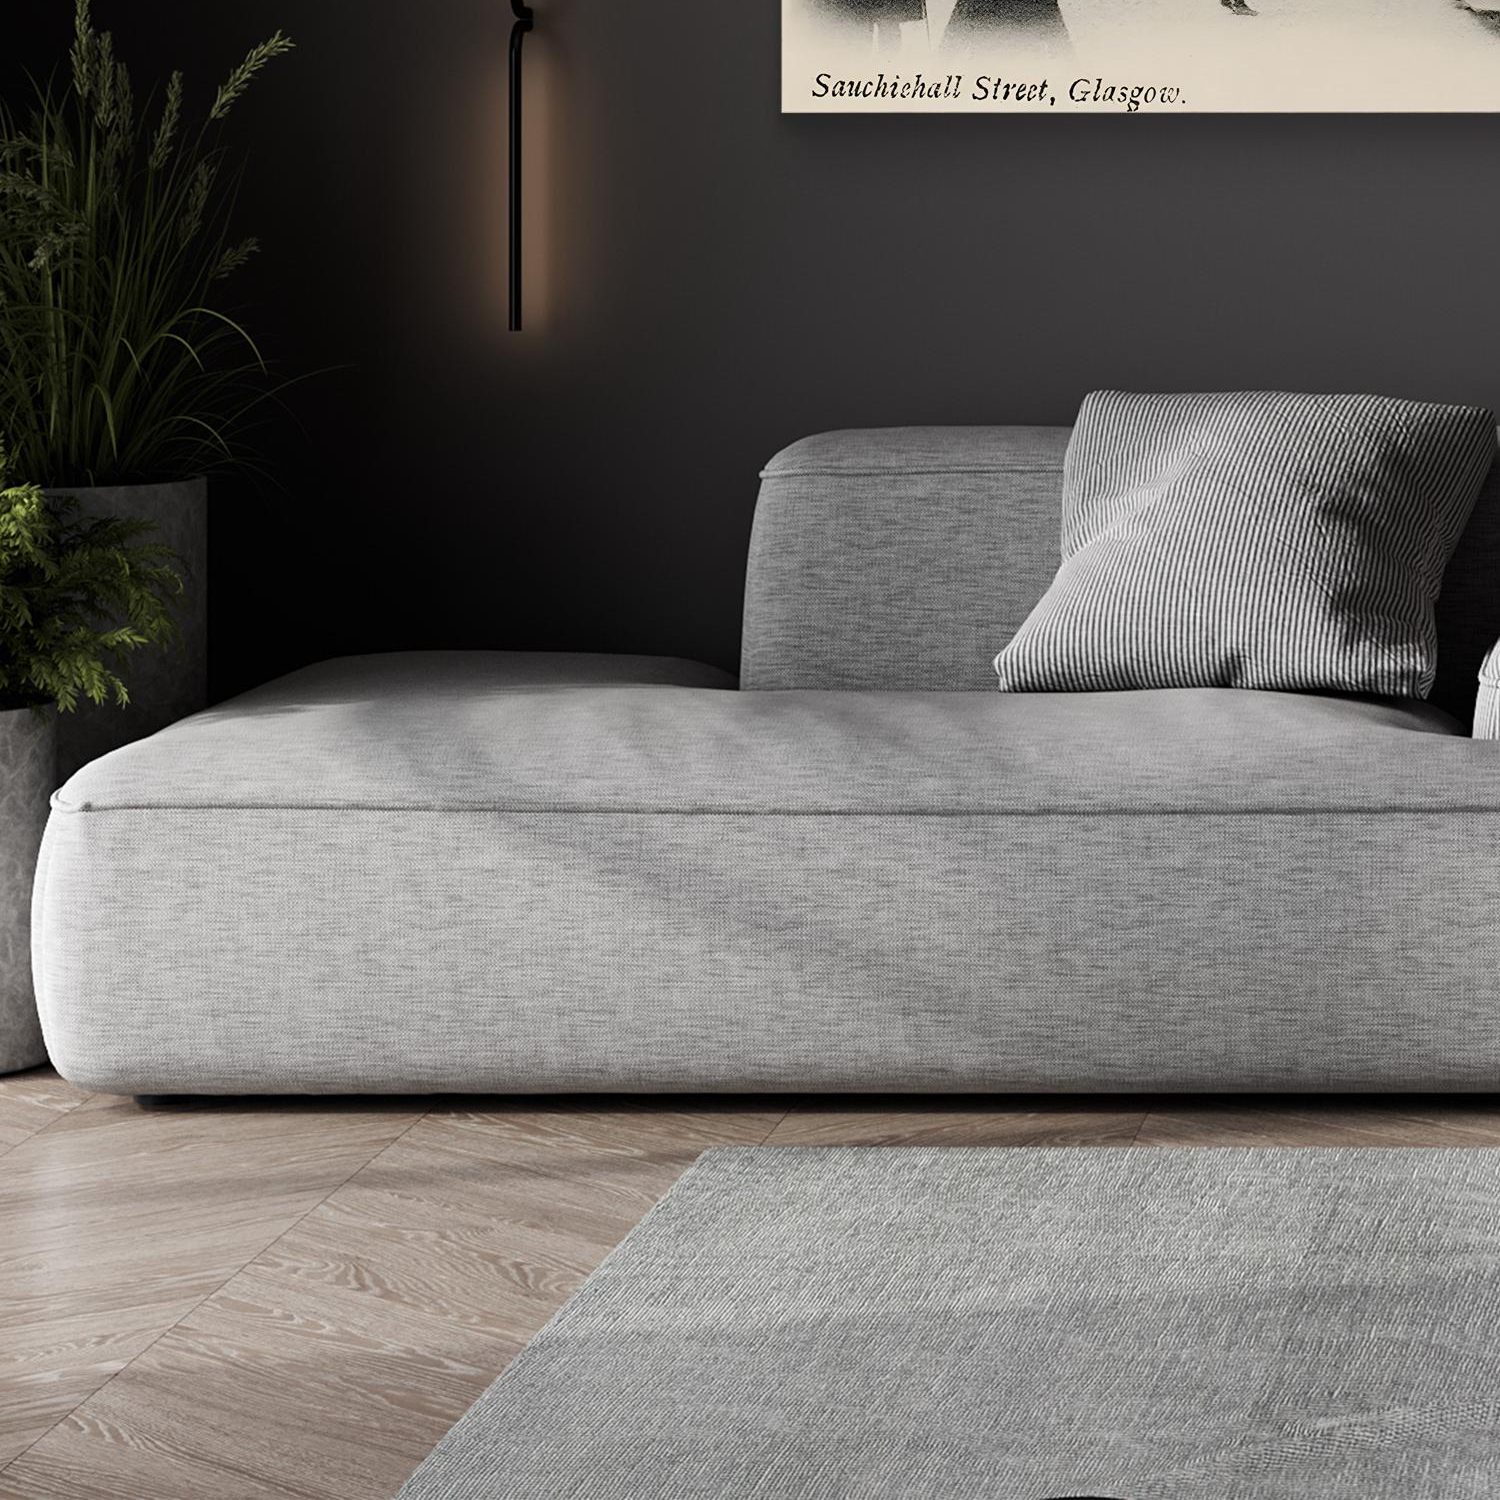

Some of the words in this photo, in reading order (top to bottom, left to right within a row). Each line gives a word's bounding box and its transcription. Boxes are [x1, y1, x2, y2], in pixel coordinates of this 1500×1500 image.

[811, 73, 962, 100] Sauchiehall
[972, 76, 1057, 106] Street,
[1068, 78, 1187, 112] Glasgow.
